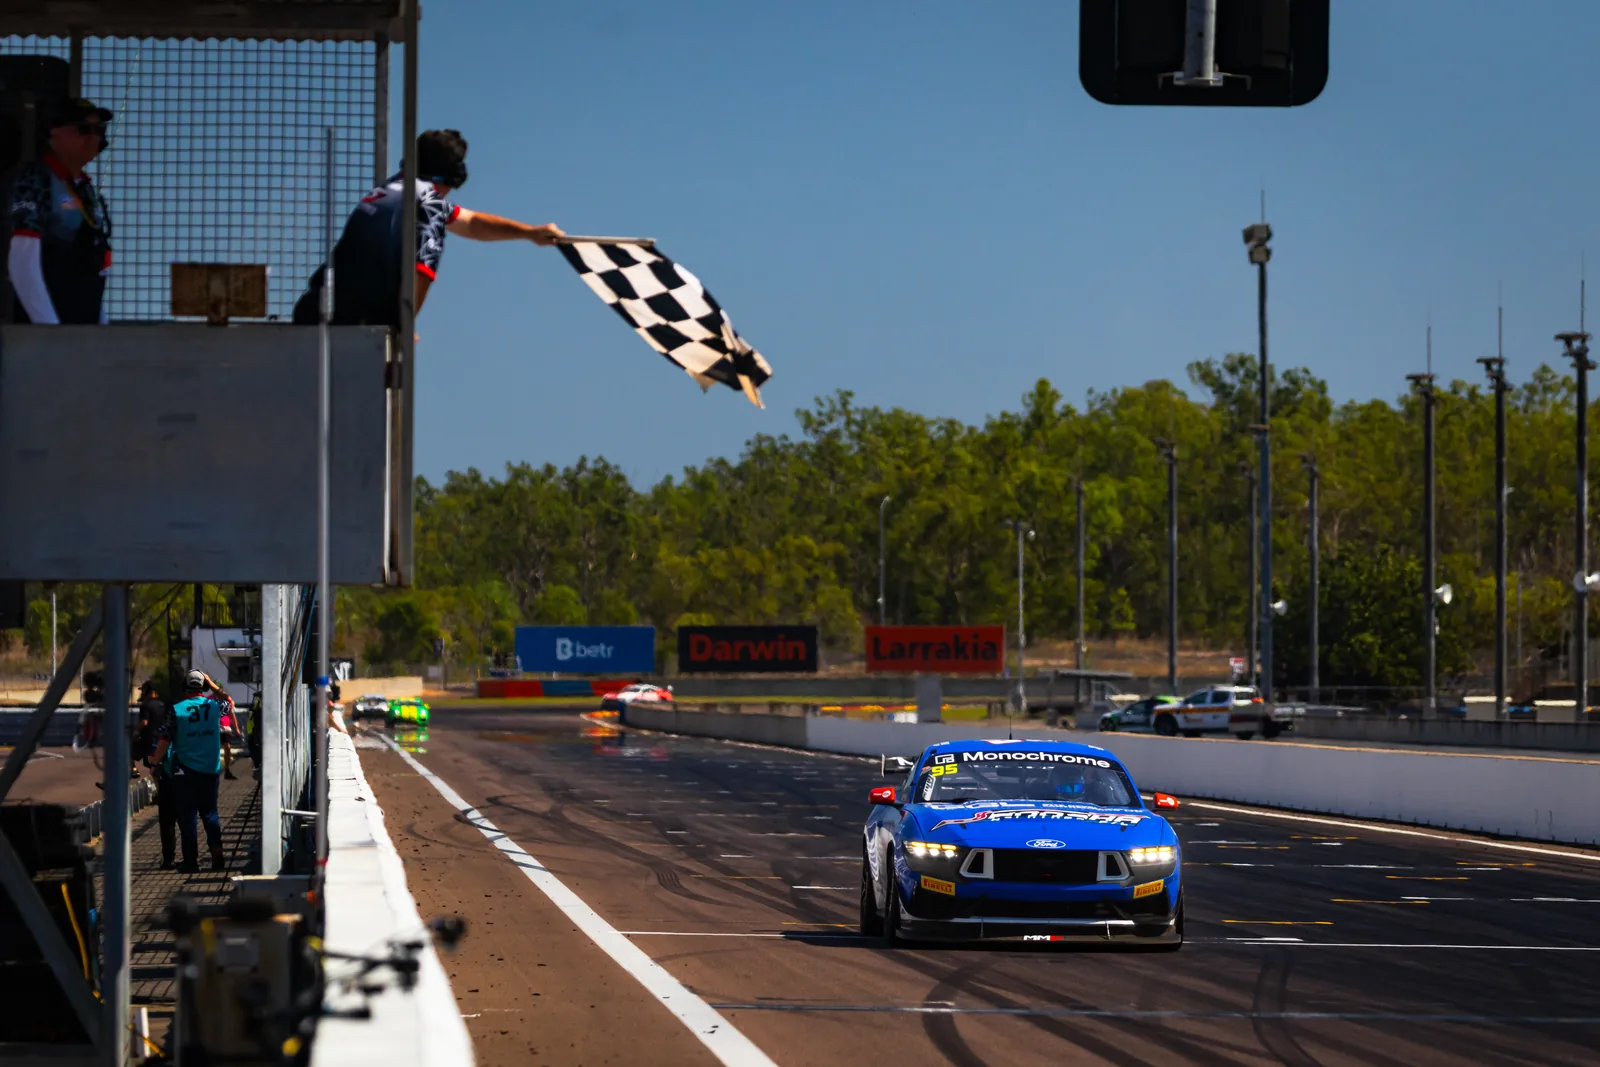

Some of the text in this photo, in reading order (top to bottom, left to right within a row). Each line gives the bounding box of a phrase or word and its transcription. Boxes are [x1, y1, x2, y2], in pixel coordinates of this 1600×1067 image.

[689, 633, 806, 660] Darwin
[873, 632, 997, 660] Larrakia
[186, 703, 211, 723] 37
[962, 751, 1110, 768] Monochrome
[931, 763, 958, 777] 95
